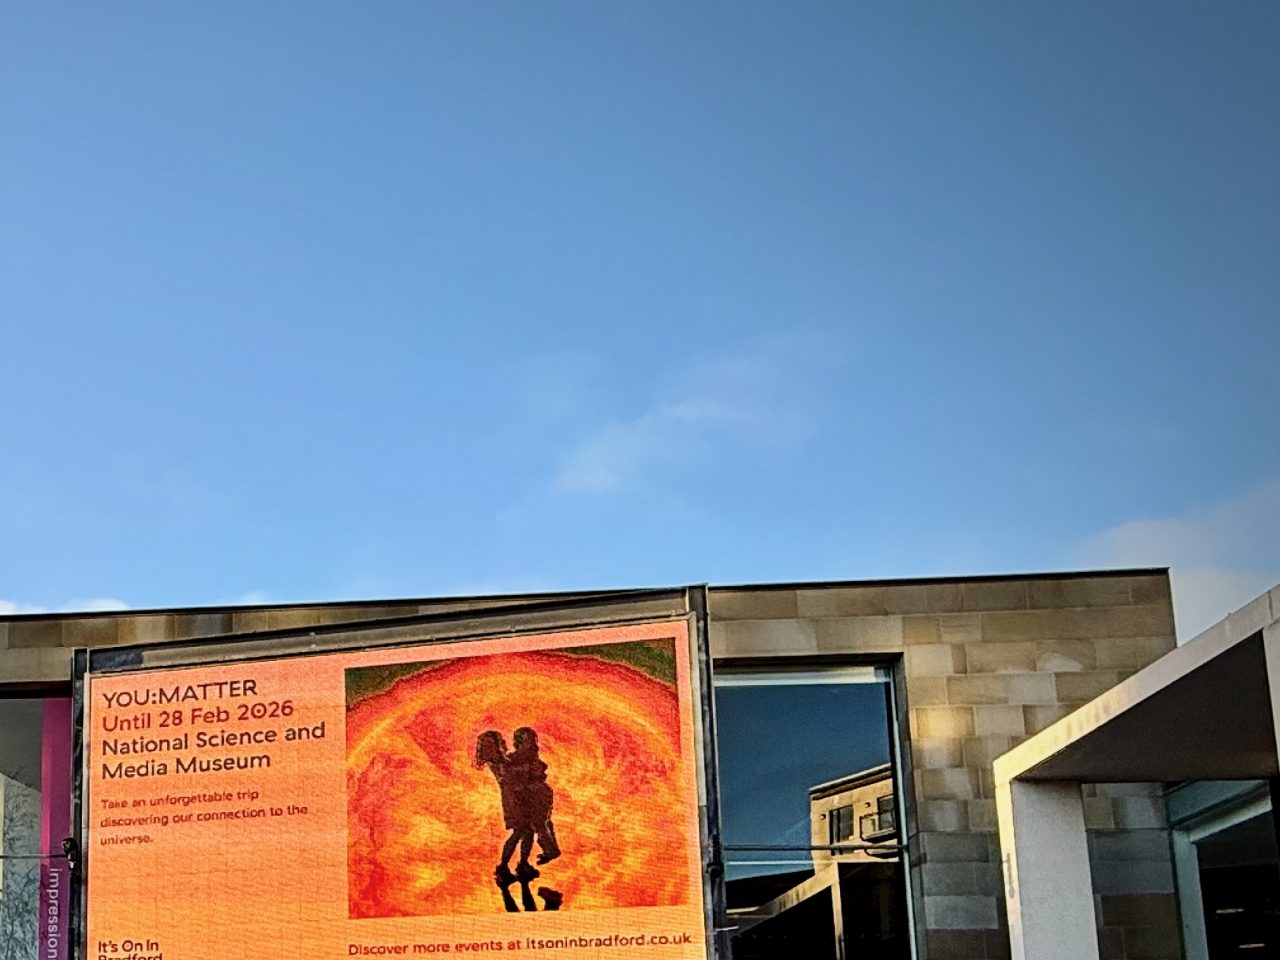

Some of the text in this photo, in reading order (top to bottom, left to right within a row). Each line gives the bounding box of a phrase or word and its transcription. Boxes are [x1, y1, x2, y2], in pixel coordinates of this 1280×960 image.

[102, 679, 258, 709] YOU:MATTER
[102, 700, 294, 732] Until 28 Feb 2026
[102, 721, 325, 756] National Science and
[102, 754, 271, 780] Media Museum
[101, 789, 259, 809] Take an unforgettable trip
[100, 804, 309, 828] discovering our connection to the
[100, 834, 154, 846] universe.
[98, 939, 159, 953] It's On In
[348, 932, 691, 955] Discover more events at itsoninbradford.co.uk
